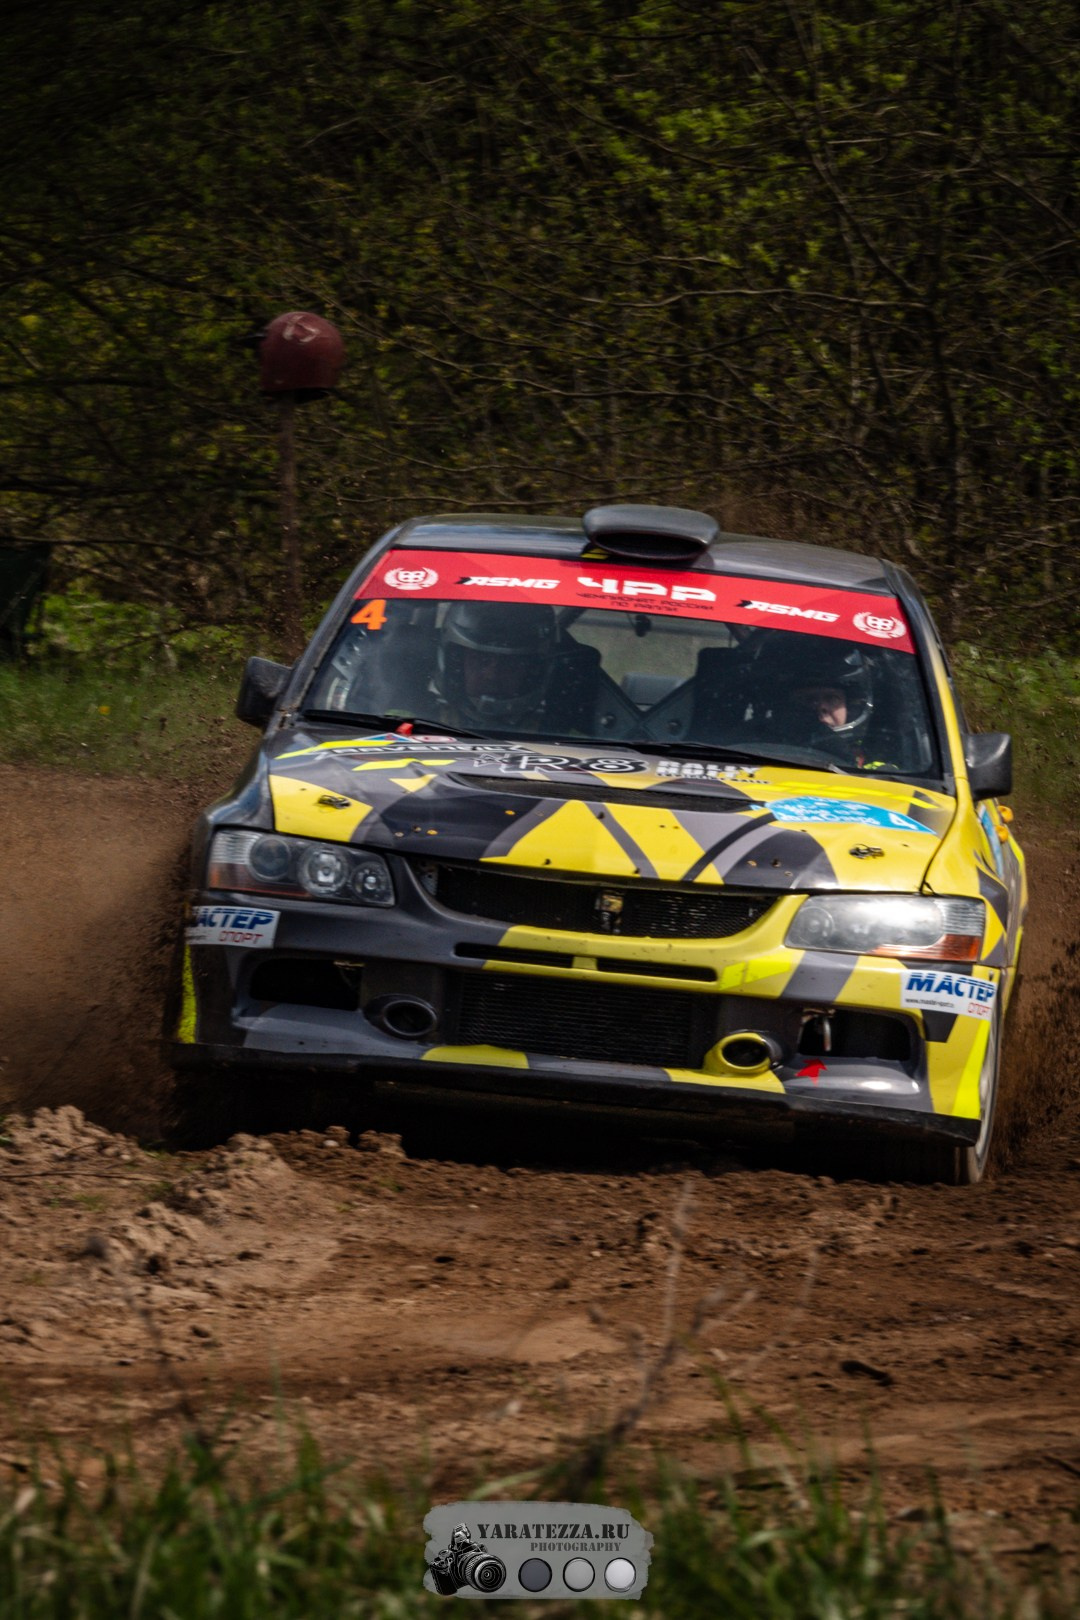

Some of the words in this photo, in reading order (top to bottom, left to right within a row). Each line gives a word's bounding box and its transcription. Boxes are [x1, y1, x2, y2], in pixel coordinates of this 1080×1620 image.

[351, 599, 388, 630] 4
[190, 907, 274, 930] АСТЕР
[905, 972, 995, 1002] МАСТЕР
